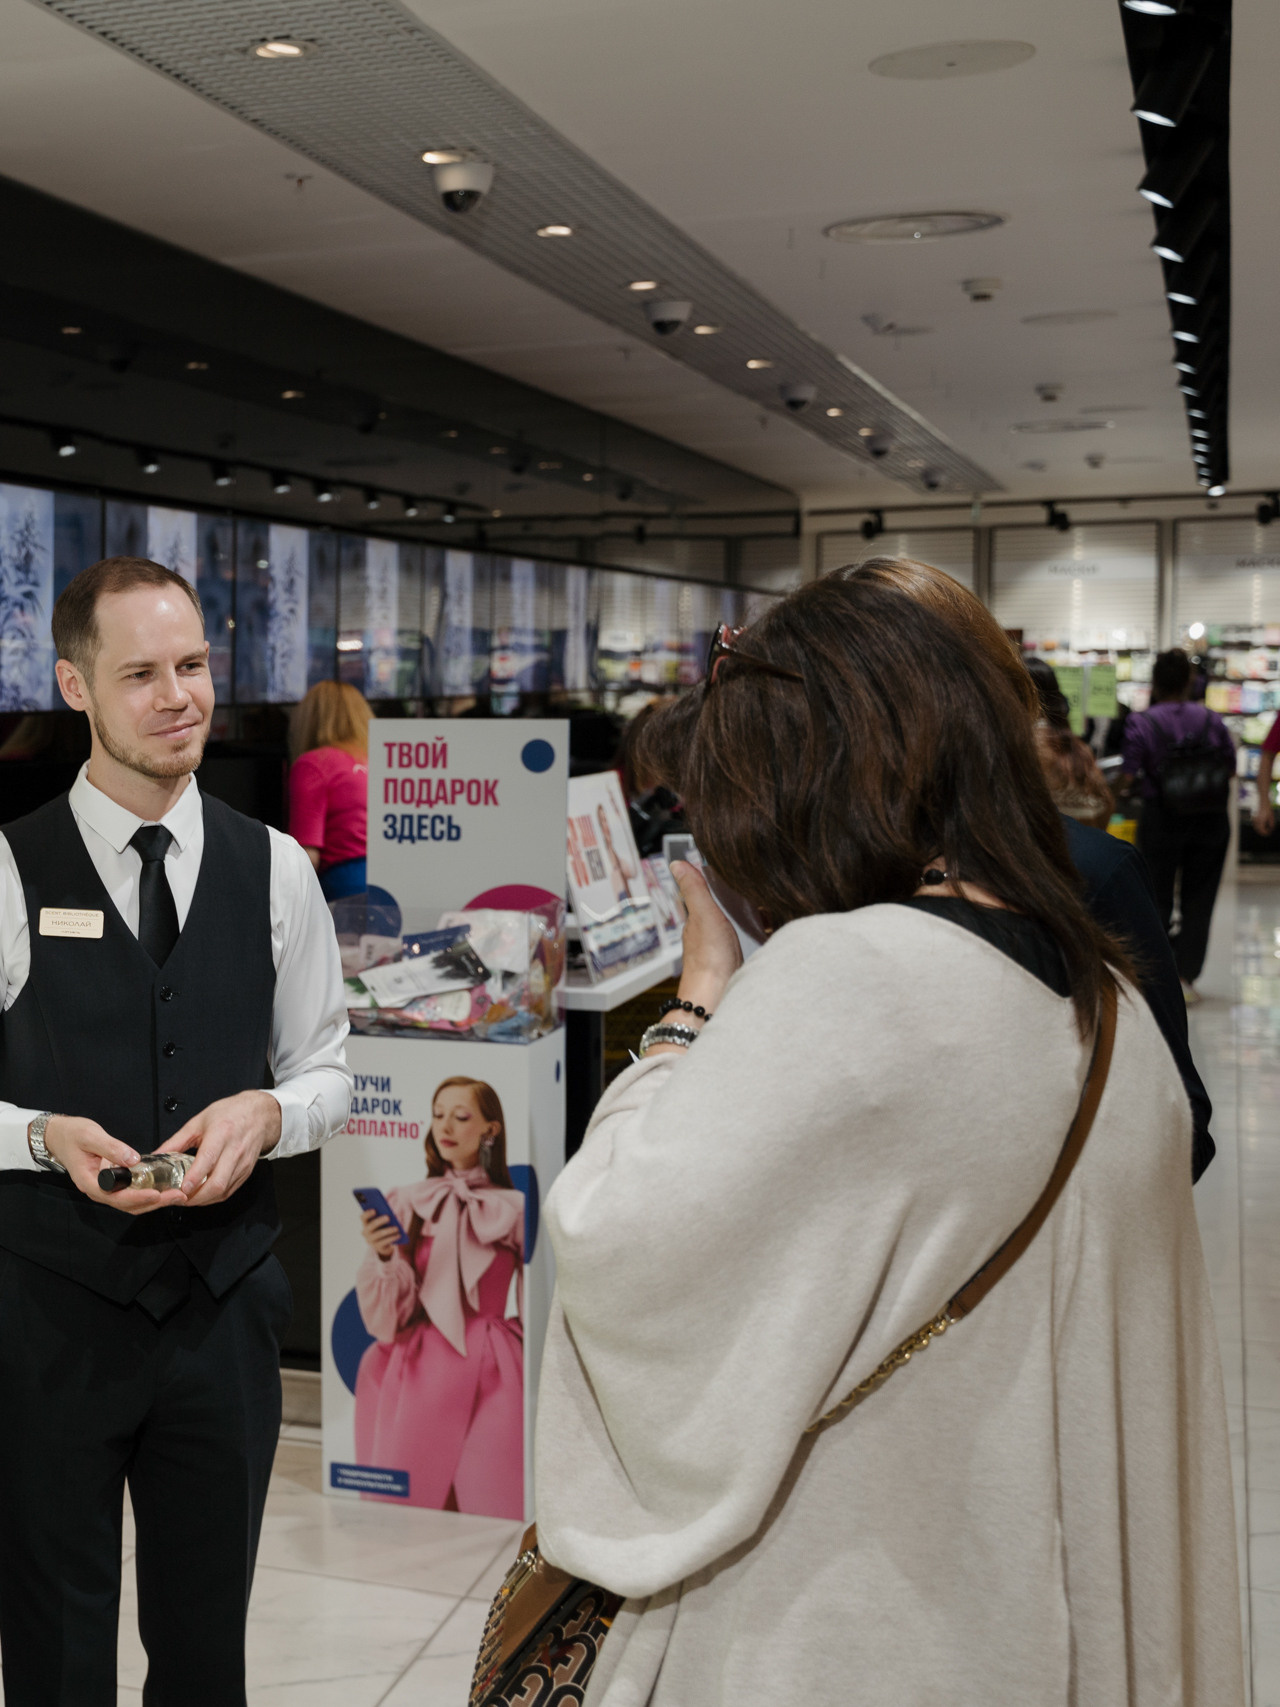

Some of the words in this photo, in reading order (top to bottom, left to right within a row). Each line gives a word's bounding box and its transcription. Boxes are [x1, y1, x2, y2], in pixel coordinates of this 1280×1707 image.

[383, 736, 448, 769] ТВОЙ
[383, 778, 499, 809] ПОДАРОК
[383, 813, 462, 844] ЗДЕСЬ
[51, 920, 92, 928] НИКОЛАЙ
[351, 1096, 402, 1116] ДАРОК
[341, 1118, 424, 1140] СПЛАТНО
